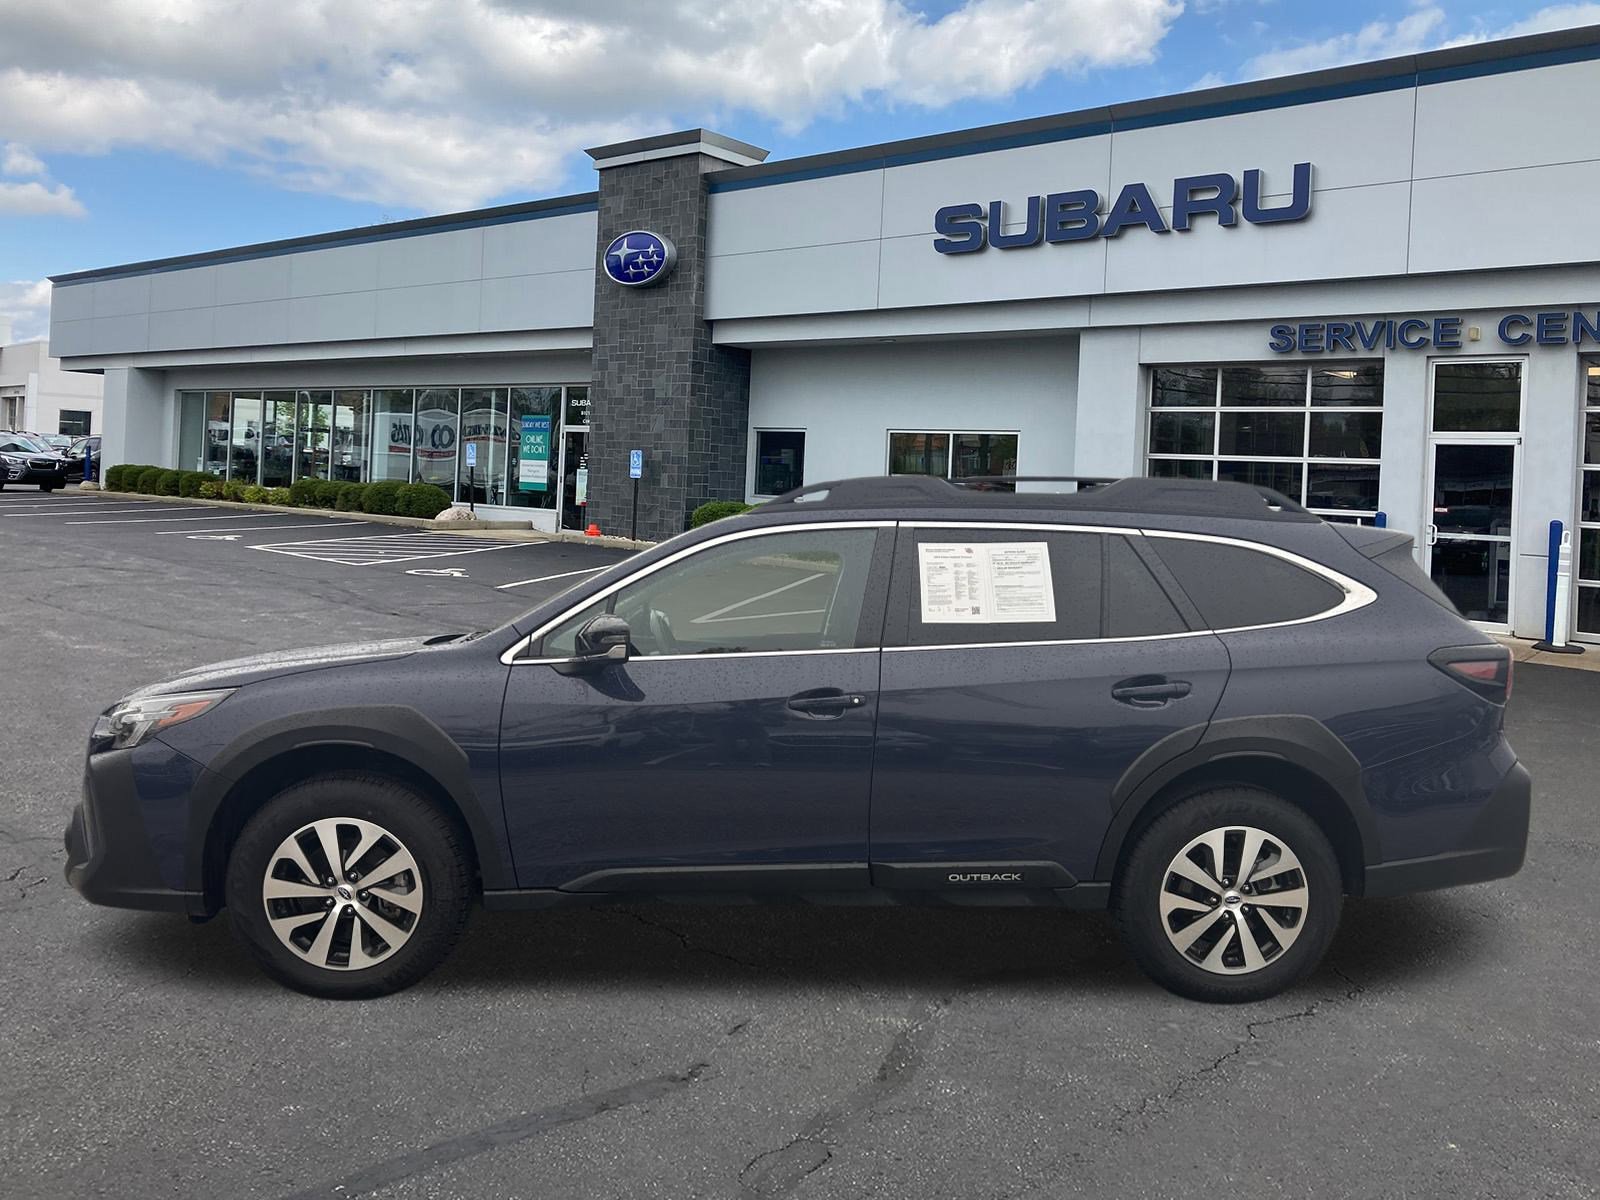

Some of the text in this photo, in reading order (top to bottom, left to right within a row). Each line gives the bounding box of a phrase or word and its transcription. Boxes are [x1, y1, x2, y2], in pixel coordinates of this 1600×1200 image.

[933, 161, 1313, 256] SUBARU
[1268, 310, 1600, 353] SERVICE CEN
[948, 873, 1021, 882] OUTBACK
